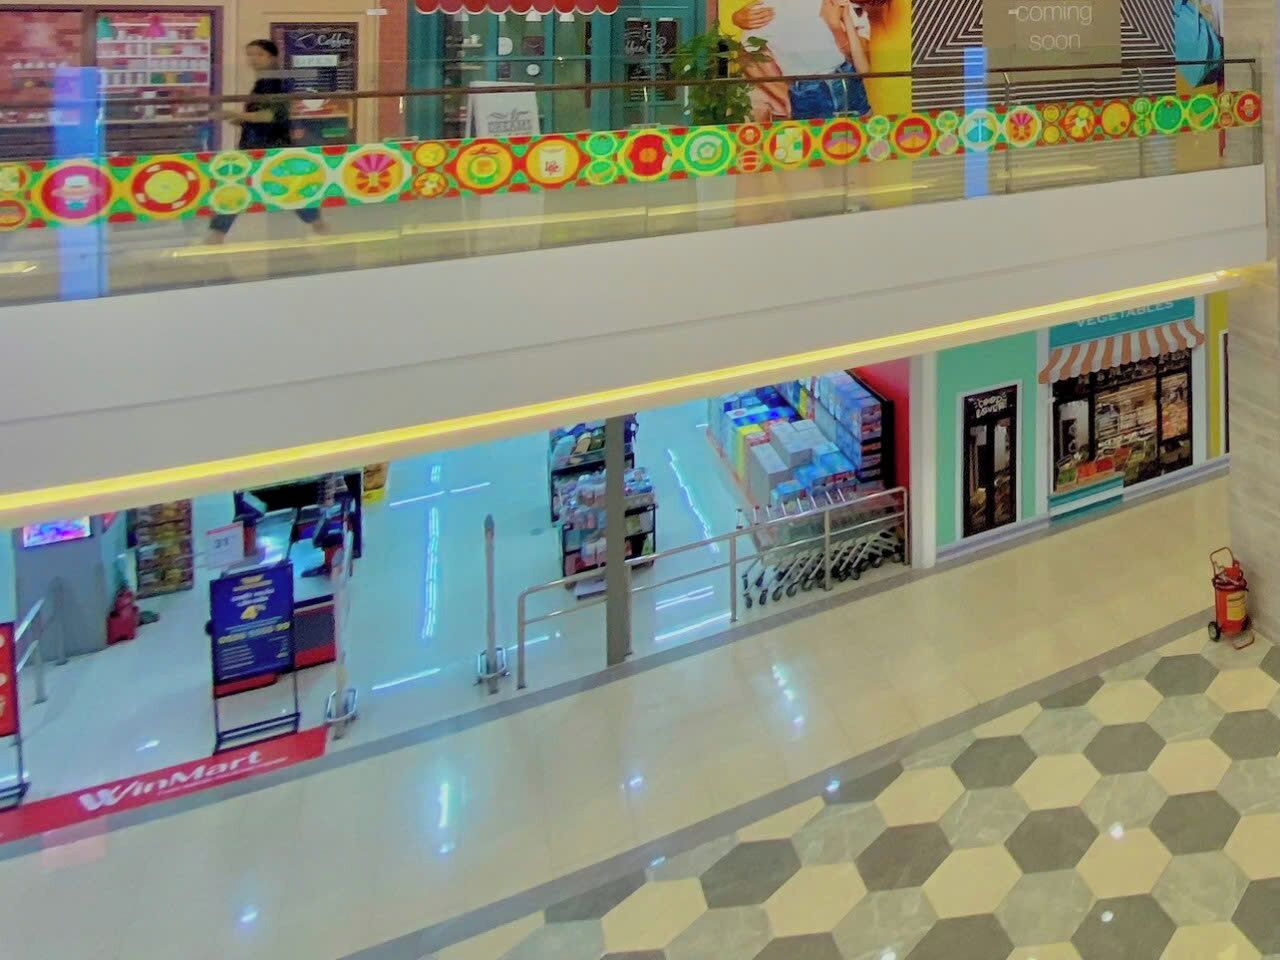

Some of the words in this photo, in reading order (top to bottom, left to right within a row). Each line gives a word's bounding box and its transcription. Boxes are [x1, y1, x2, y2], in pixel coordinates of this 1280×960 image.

[1016, 5, 1093, 26] coming
[1030, 34, 1081, 51] soon
[79, 750, 262, 812] WinMart
